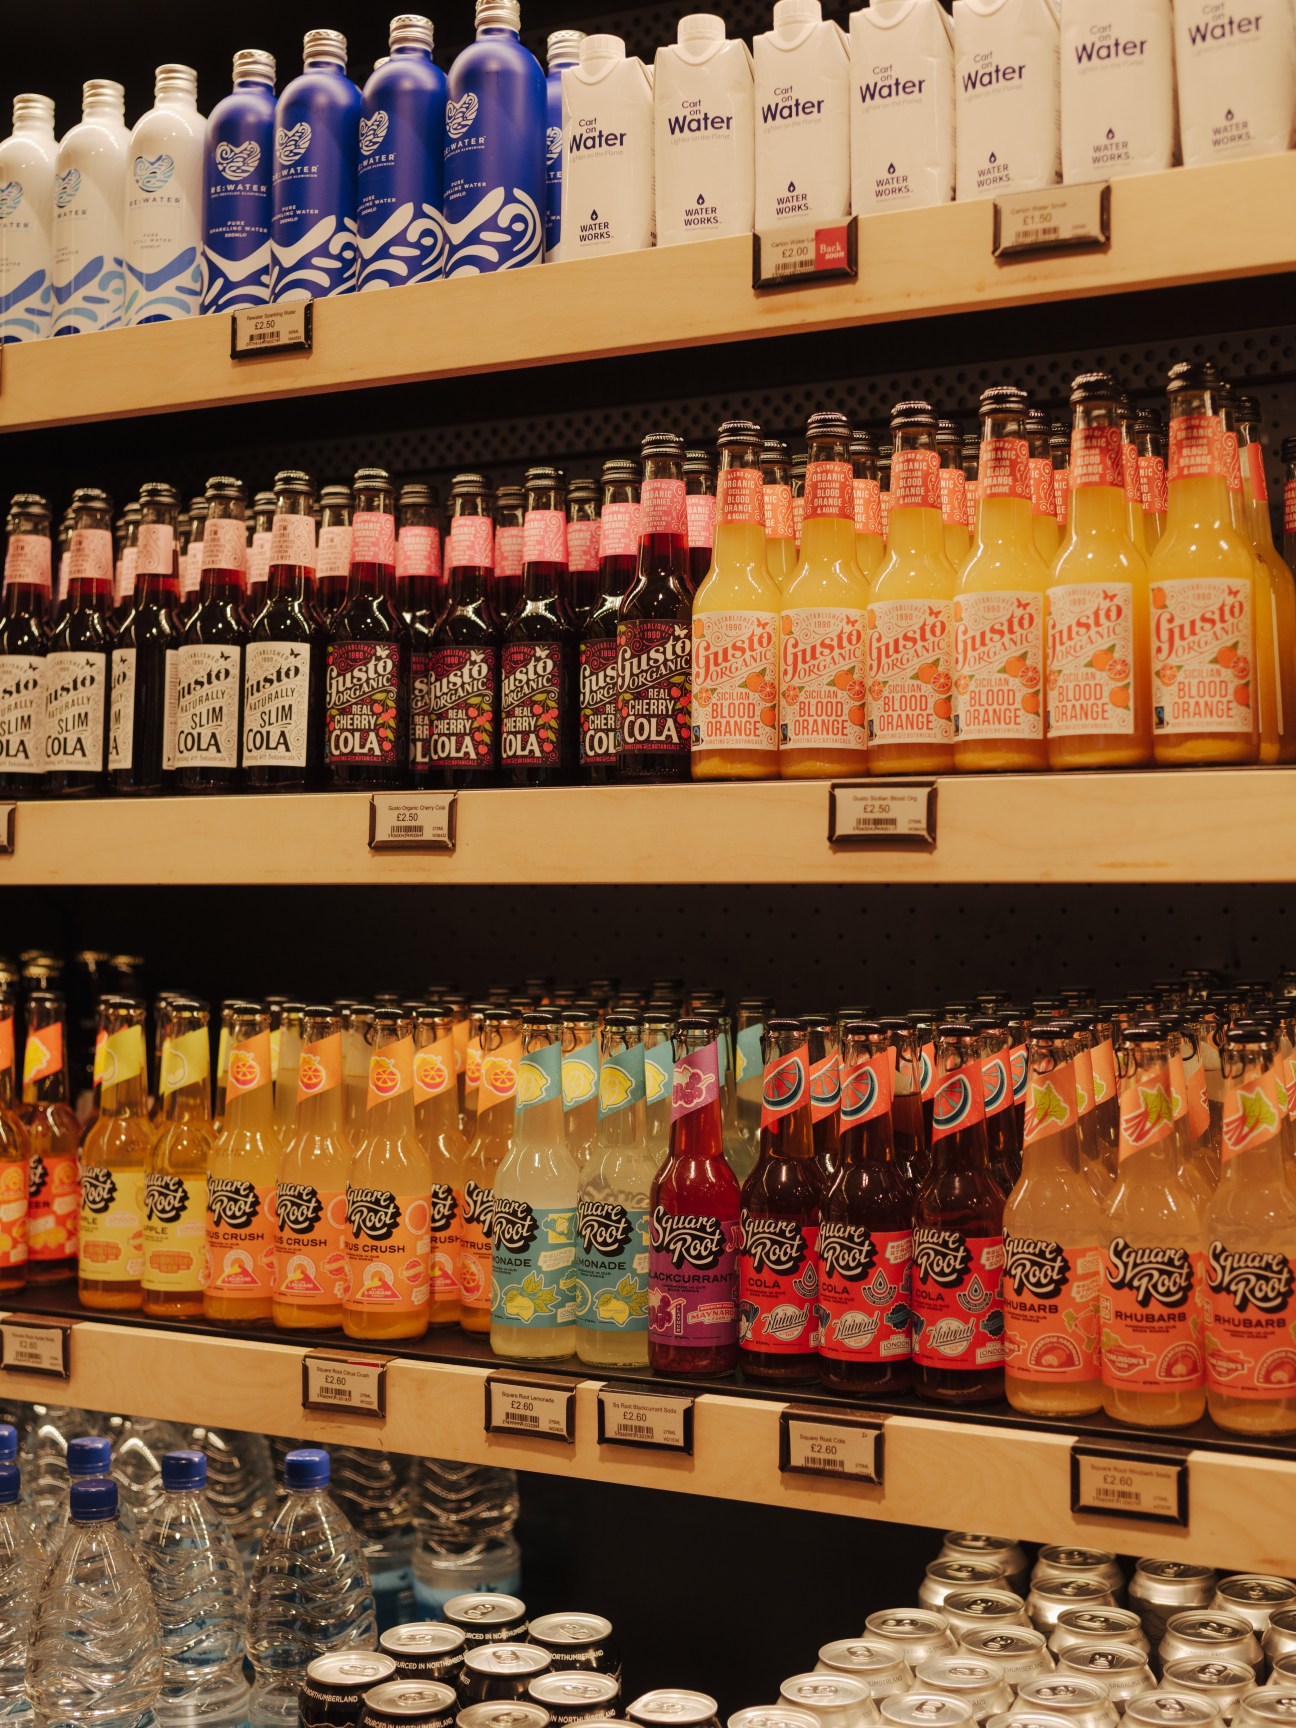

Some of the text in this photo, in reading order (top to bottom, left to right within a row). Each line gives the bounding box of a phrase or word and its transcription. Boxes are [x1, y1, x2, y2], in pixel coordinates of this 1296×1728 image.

[1188, 15, 1263, 46] Water
[974, 51, 993, 63] Cart
[1075, 38, 1148, 64] Water
[872, 64, 893, 75] Cart
[962, 64, 1026, 92] Water
[773, 85, 793, 96] Cart
[860, 76, 925, 104] Water
[681, 98, 701, 109] Cart
[762, 98, 824, 123] Water
[578, 117, 598, 128] Cart
[668, 112, 733, 135] Water
[978, 164, 1009, 178] WATER
[876, 175, 908, 188] WATER
[977, 174, 1010, 188] WORKS
[210, 184, 267, 194] RE:WATER
[875, 184, 910, 198] WORKS
[776, 193, 808, 206] WATER
[684, 206, 717, 218] WATER
[776, 203, 809, 216] WORKS
[684, 216, 719, 227] WORKS
[1022, 213, 1052, 226] £1.50
[580, 222, 610, 233] WATER
[578, 230, 611, 242] WORKS
[782, 246, 808, 258] £2.00
[820, 242, 842, 254] Back
[825, 251, 845, 260] soon
[254, 320, 276, 330] £2.50
[724, 478, 754, 490] ORGANIC
[812, 472, 845, 482] ORGANIC
[728, 495, 750, 504] BLOOD
[816, 488, 840, 497] BLOOD
[724, 504, 752, 513] ORANGE
[814, 498, 842, 506] ORANGE
[814, 620, 832, 628] 1990
[896, 613, 914, 621] 1990
[725, 624, 742, 632] 1990
[1156, 599, 1244, 662] Gusto
[954, 609, 1034, 672] Gusto
[1056, 622, 1122, 664] ORGANIC
[1174, 620, 1244, 658] ORGANIC
[782, 626, 862, 684] Gusto
[868, 618, 946, 678] Gusto
[968, 631, 1034, 668] ORGANIC
[694, 628, 772, 686] Gusto
[882, 638, 945, 675] ORGANIC
[709, 649, 772, 682] ORGANIC
[798, 646, 860, 682] ORGANIC
[629, 656, 690, 689] ORGANIC
[1062, 672, 1096, 683] SICILIAN
[1182, 668, 1222, 680] SICILIAN
[335, 674, 392, 706] ORGANIC
[888, 684, 922, 694] SICILIAN
[974, 678, 1009, 688] SICILIAN
[1177, 680, 1228, 699] BLOOD
[248, 688, 296, 712] NATURALLY
[434, 678, 487, 710] ORGANIC
[648, 688, 670, 699] REAL
[716, 692, 750, 701] SICILIAN
[804, 690, 838, 699] SICILIAN
[969, 688, 1016, 707] BLOOD
[1058, 683, 1104, 703] BLOOD
[180, 689, 226, 713] NATURALLY
[628, 700, 674, 715] CHERRY
[883, 694, 928, 713] BLOOD
[352, 704, 372, 714] REAL
[448, 710, 468, 719] REAL
[514, 706, 532, 717] REAL
[711, 702, 756, 719] BLOOD
[800, 700, 844, 718] BLOOD
[1054, 702, 1110, 723] ORANGE
[1172, 700, 1234, 720] ORANGE
[58, 712, 88, 735] SLIM
[190, 706, 223, 730] SLIM
[260, 704, 293, 729] SLIM
[334, 715, 376, 730] CHERRY
[879, 713, 934, 732] ORANGE
[965, 708, 1021, 727] ORANGE
[433, 719, 472, 734] CHERRY
[504, 718, 536, 732] CHERRY
[624, 716, 680, 744] COLA
[706, 720, 760, 738] ORANGE
[793, 719, 848, 736] ORANGE
[177, 731, 222, 754] COLA
[246, 729, 290, 754] COLA
[330, 730, 382, 756] COLA
[430, 735, 478, 760] COLA
[502, 733, 542, 758] COLA
[864, 804, 890, 814] £2.50
[396, 812, 418, 822] £2.50
[651, 1205, 716, 1250] Square
[222, 1232, 265, 1242] CRUSH
[286, 1238, 328, 1248] CRUSH
[362, 1244, 406, 1254] CRUSH
[669, 1229, 722, 1264] Root
[752, 1234, 802, 1270] Root
[1106, 1237, 1185, 1284] Square
[1206, 1240, 1284, 1288] Square
[748, 1278, 781, 1290] COLA
[821, 1282, 850, 1295] COLA
[1131, 1266, 1190, 1304] Root
[1232, 1272, 1289, 1308] Root
[916, 1288, 945, 1301] COLA
[1115, 1310, 1187, 1323] RHUBARB
[1214, 1314, 1287, 1328] RHUBARB
[325, 1375, 346, 1386] £2.60
[510, 1400, 534, 1412] £2.60
[530, 1396, 554, 1404] Lemonade
[633, 1404, 662, 1412] Blackcurrant
[623, 1411, 647, 1422] £2.60
[800, 1434, 818, 1442] Square
[810, 1444, 837, 1455] £2.60
[1103, 1474, 1133, 1487] £2.60
